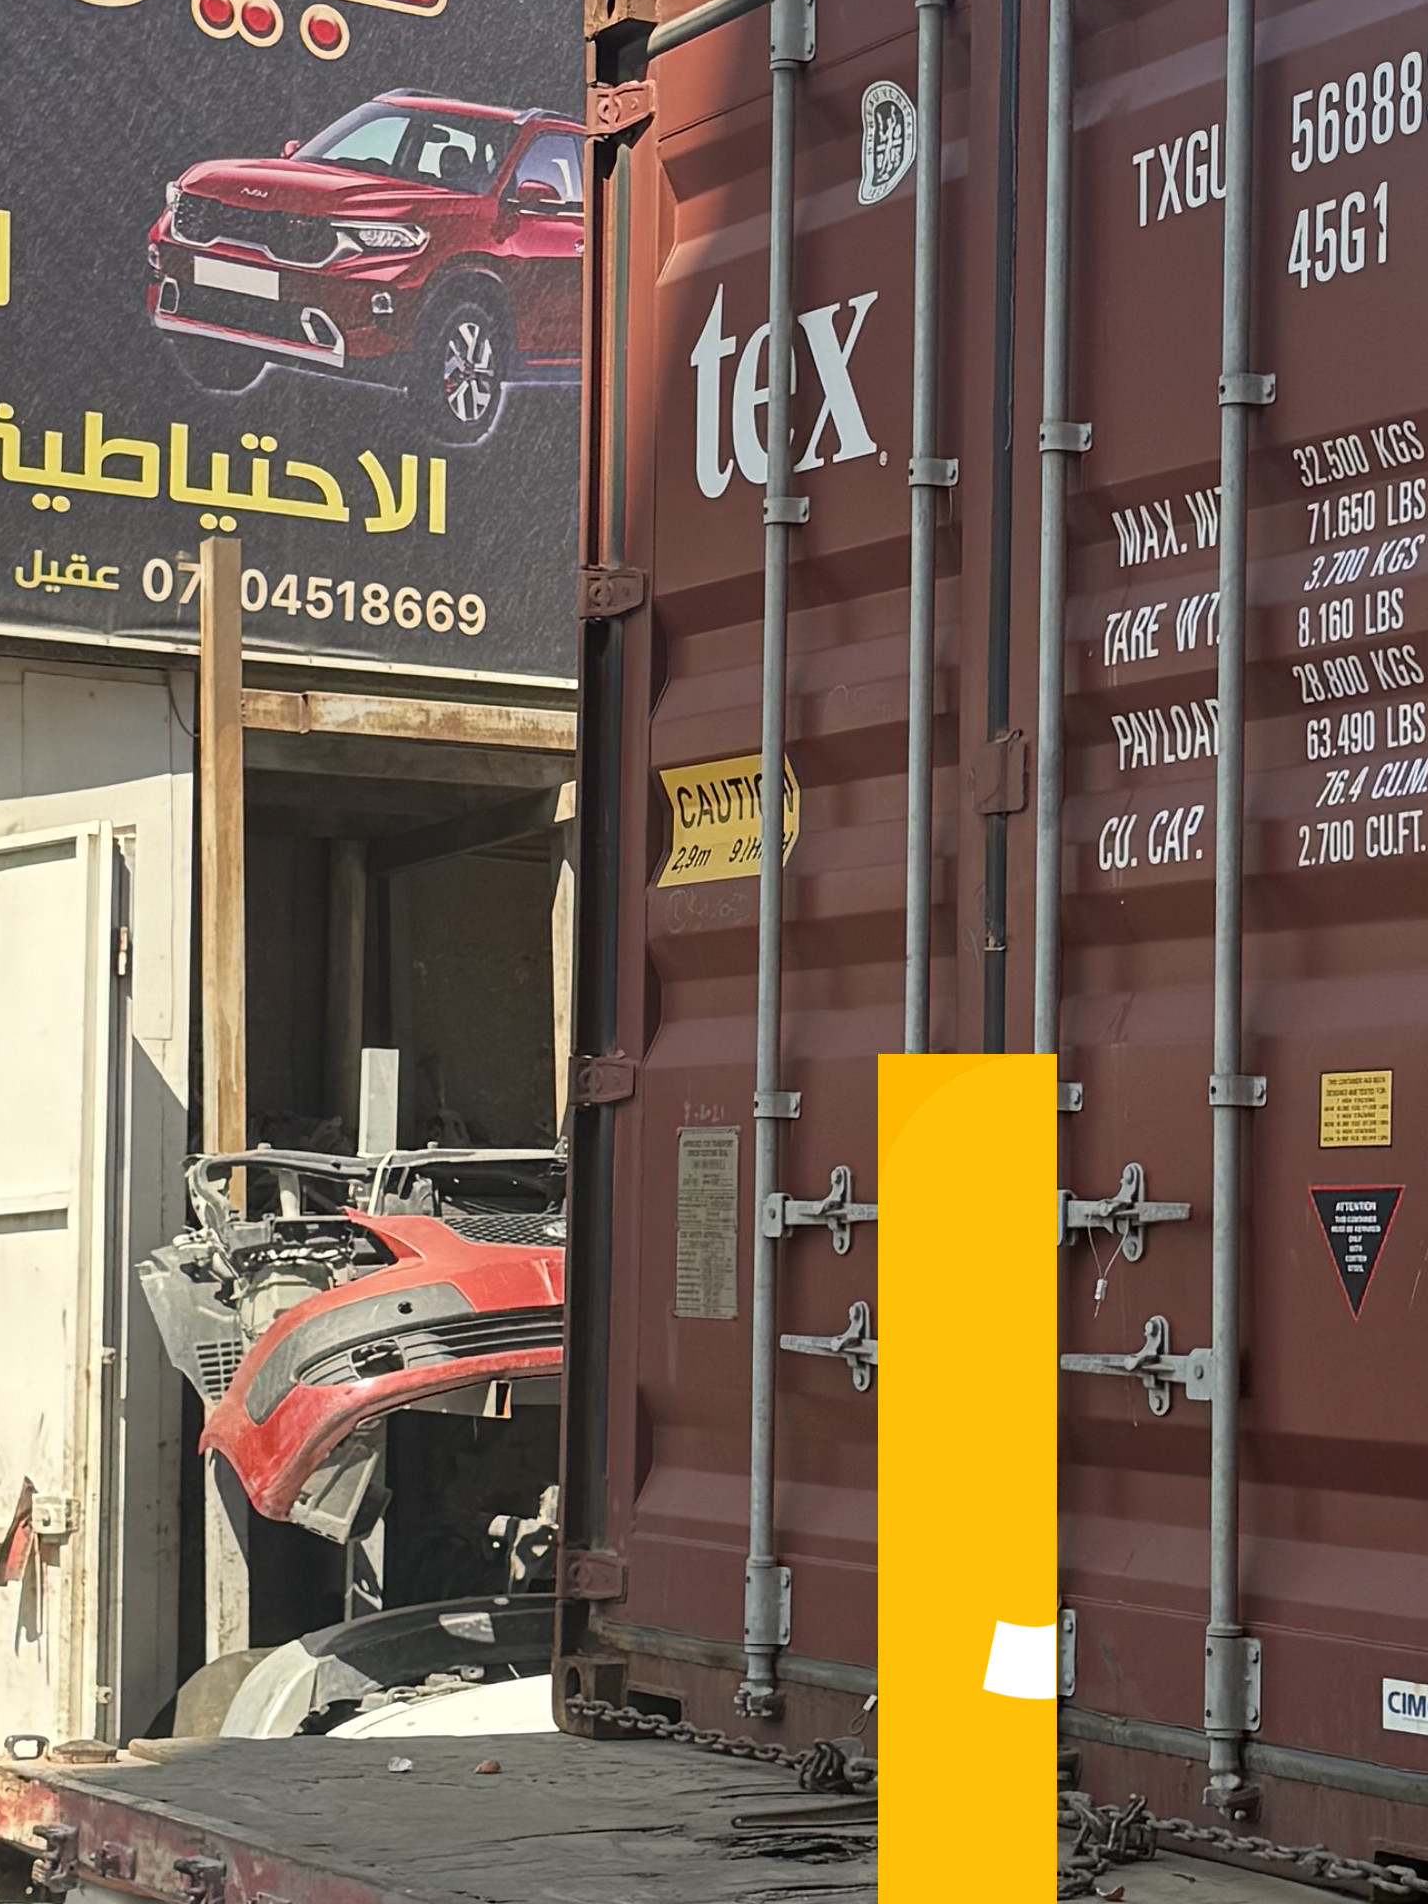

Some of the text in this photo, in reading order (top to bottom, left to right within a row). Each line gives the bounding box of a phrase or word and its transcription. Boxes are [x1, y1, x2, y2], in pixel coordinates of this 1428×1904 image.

[1288, 181, 1388, 289] 45G1
[690, 283, 878, 499] tex
[1112, 498, 1188, 568] MAX.
[1292, 433, 1370, 488] 32.500
[1370, 419, 1425, 469] KGS
[1307, 478, 1427, 545] 71.650 LBS
[14, 549, 120, 593] عقيل
[142, 557, 487, 637] 0704518669
[1103, 602, 1168, 667] TARE
[1303, 544, 1370, 592] 3.700
[1370, 534, 1426, 578] KGS
[1298, 588, 1405, 648] 8.160 LBS
[1292, 654, 1369, 704] 28.800
[1370, 645, 1425, 691] KGS
[1306, 701, 1427, 761] 63.490 LBS
[1098, 814, 1139, 872] CU.
[1148, 804, 1205, 865] CAP.
[1315, 765, 1370, 808] 76.4
[1298, 810, 1427, 868] 2.700 CU.FT.
